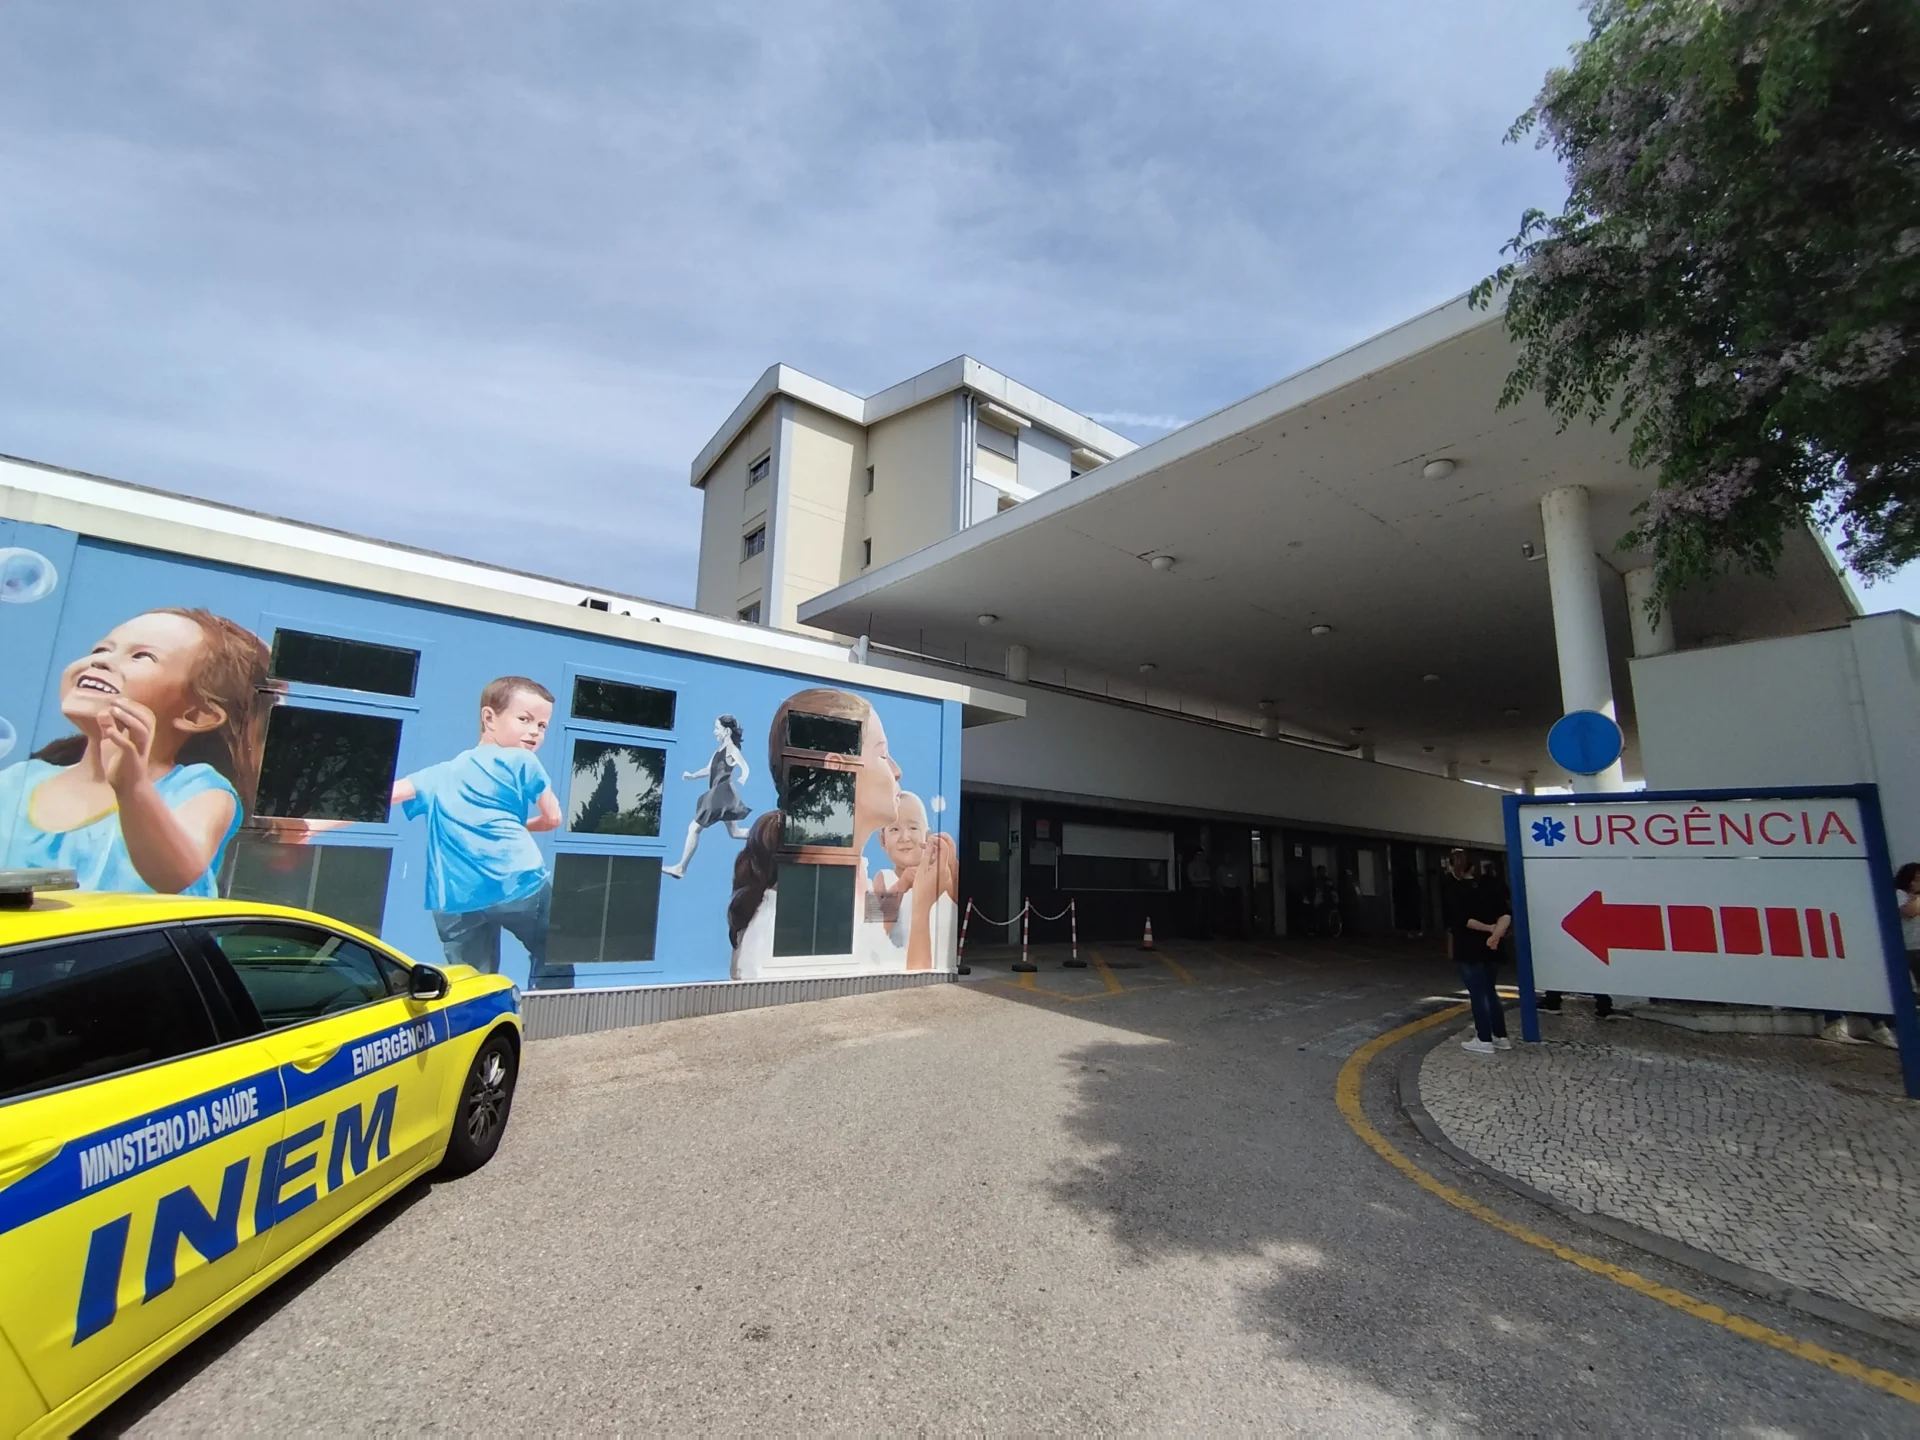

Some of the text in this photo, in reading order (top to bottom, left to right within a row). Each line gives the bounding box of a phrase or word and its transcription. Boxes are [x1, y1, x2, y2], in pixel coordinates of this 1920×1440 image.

[1574, 807, 1857, 845] URGÊNCIA
[352, 1021, 436, 1075] EMERGÊNCIA
[80, 1087, 259, 1190] MINISTÉRIO DA SAÚDE
[72, 1086, 398, 1347] INEM
